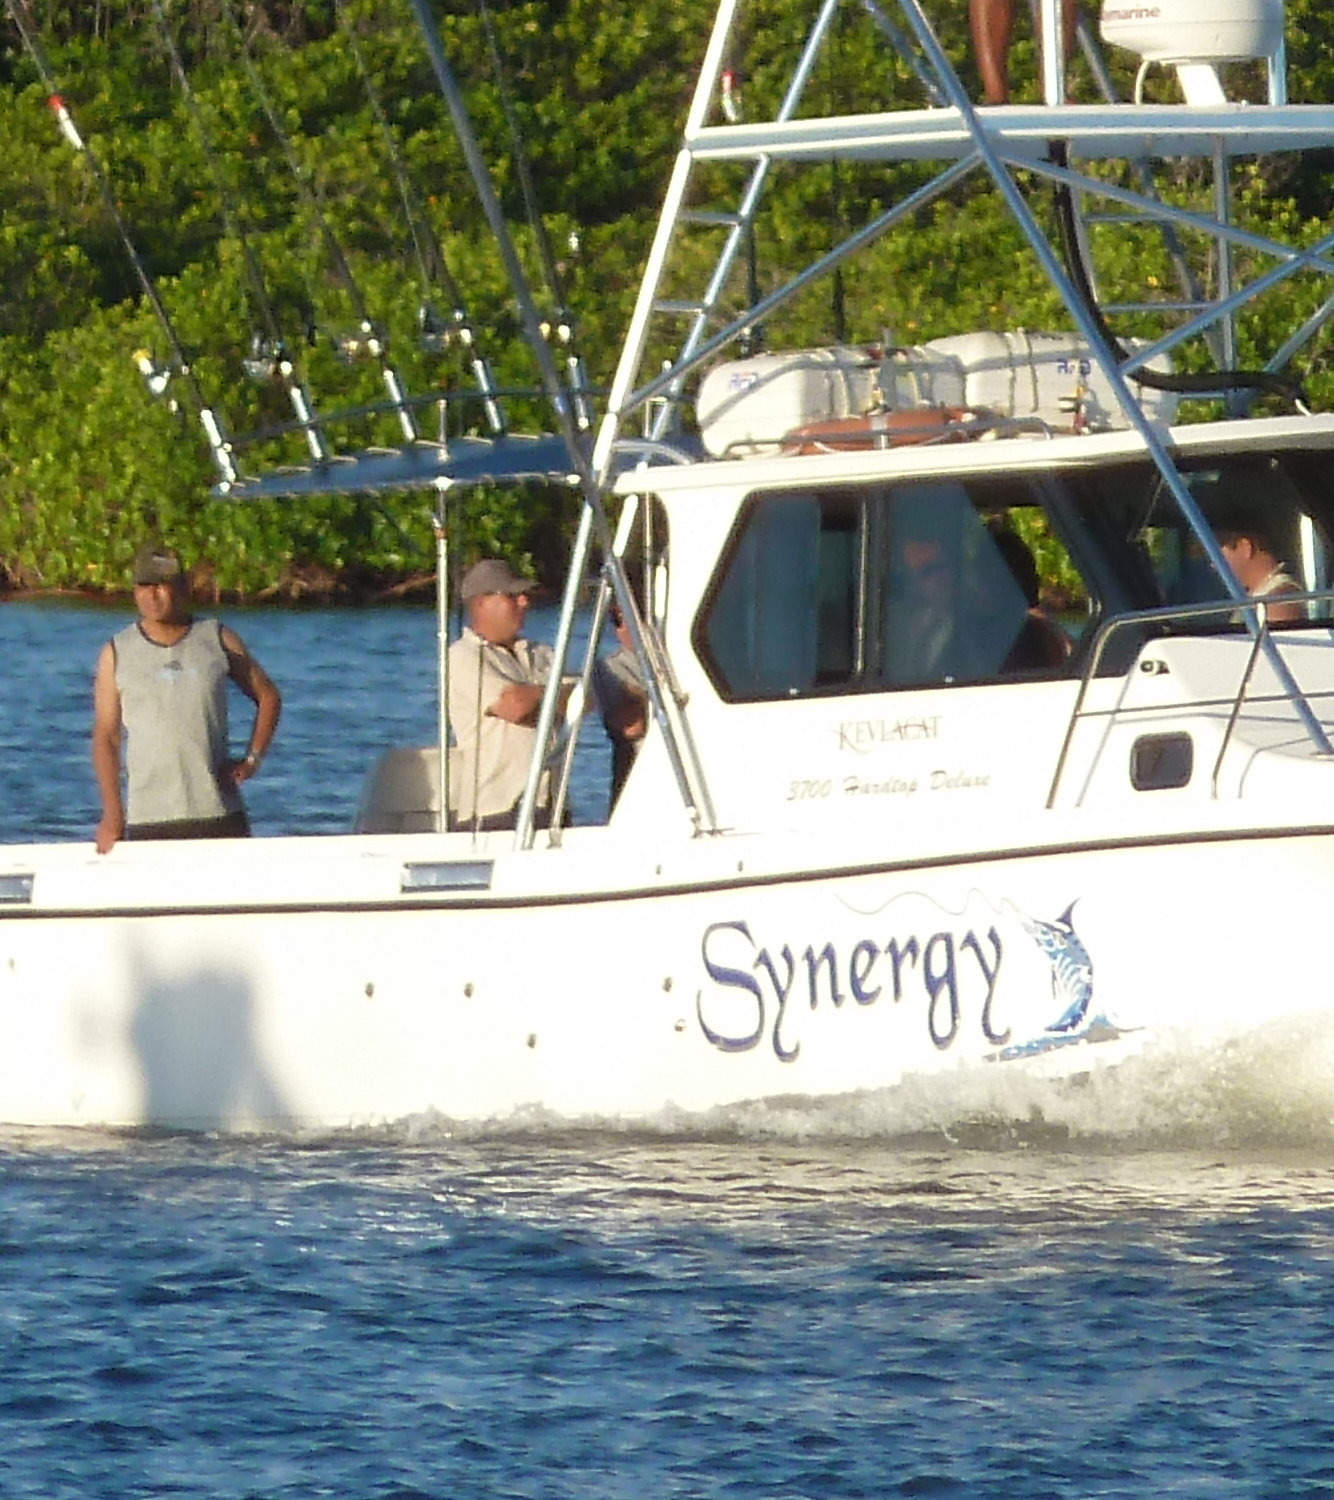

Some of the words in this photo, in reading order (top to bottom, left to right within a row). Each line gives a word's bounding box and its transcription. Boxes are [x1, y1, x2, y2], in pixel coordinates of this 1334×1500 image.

[831, 713, 943, 754] KEVLACAT
[786, 779, 832, 801] 3700
[843, 775, 919, 797] Hardtop
[930, 770, 992, 791] Deluxe
[696, 920, 1012, 1063] Synergy
